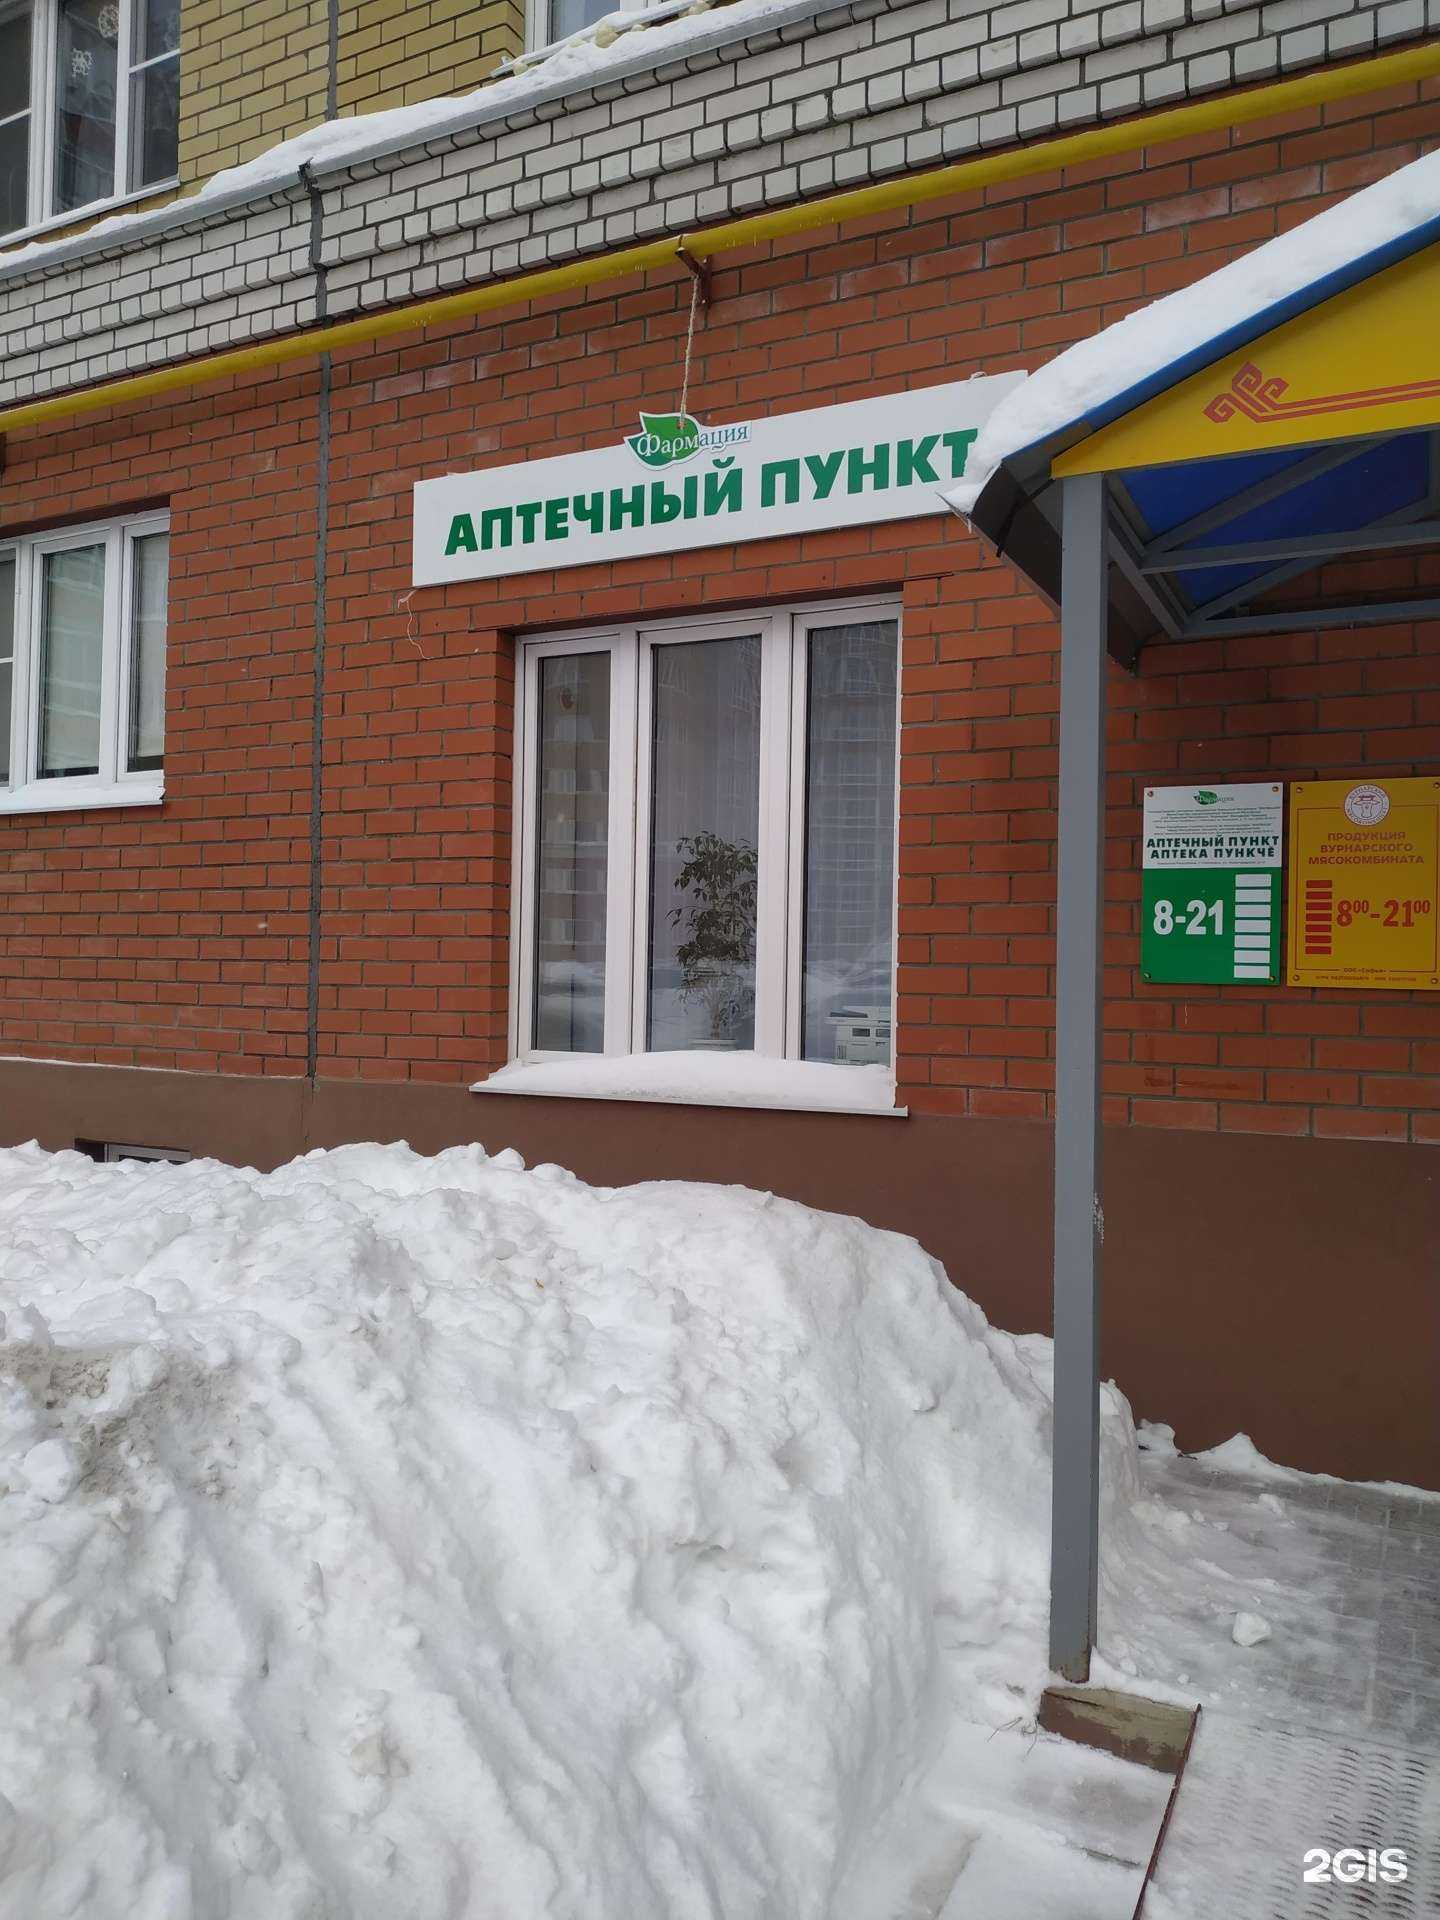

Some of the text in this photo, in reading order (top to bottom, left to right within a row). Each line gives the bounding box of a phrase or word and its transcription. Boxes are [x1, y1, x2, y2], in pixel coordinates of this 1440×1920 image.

[637, 422, 749, 458] Фармация
[444, 427, 979, 556] АПТЕЧНЫЙ ПУНКТ
[1147, 835, 1279, 848] АПТЕЧНЫЙ ПУНКТ
[1328, 832, 1405, 842] ПРОДУКЦИЯ
[1151, 848, 1208, 859] АПТЕКА
[1320, 843, 1413, 853] ВУРНАРСКОГО
[1308, 855, 1424, 865] МЯСОКОМБИНАТА
[1153, 900, 1224, 935] 8-21
